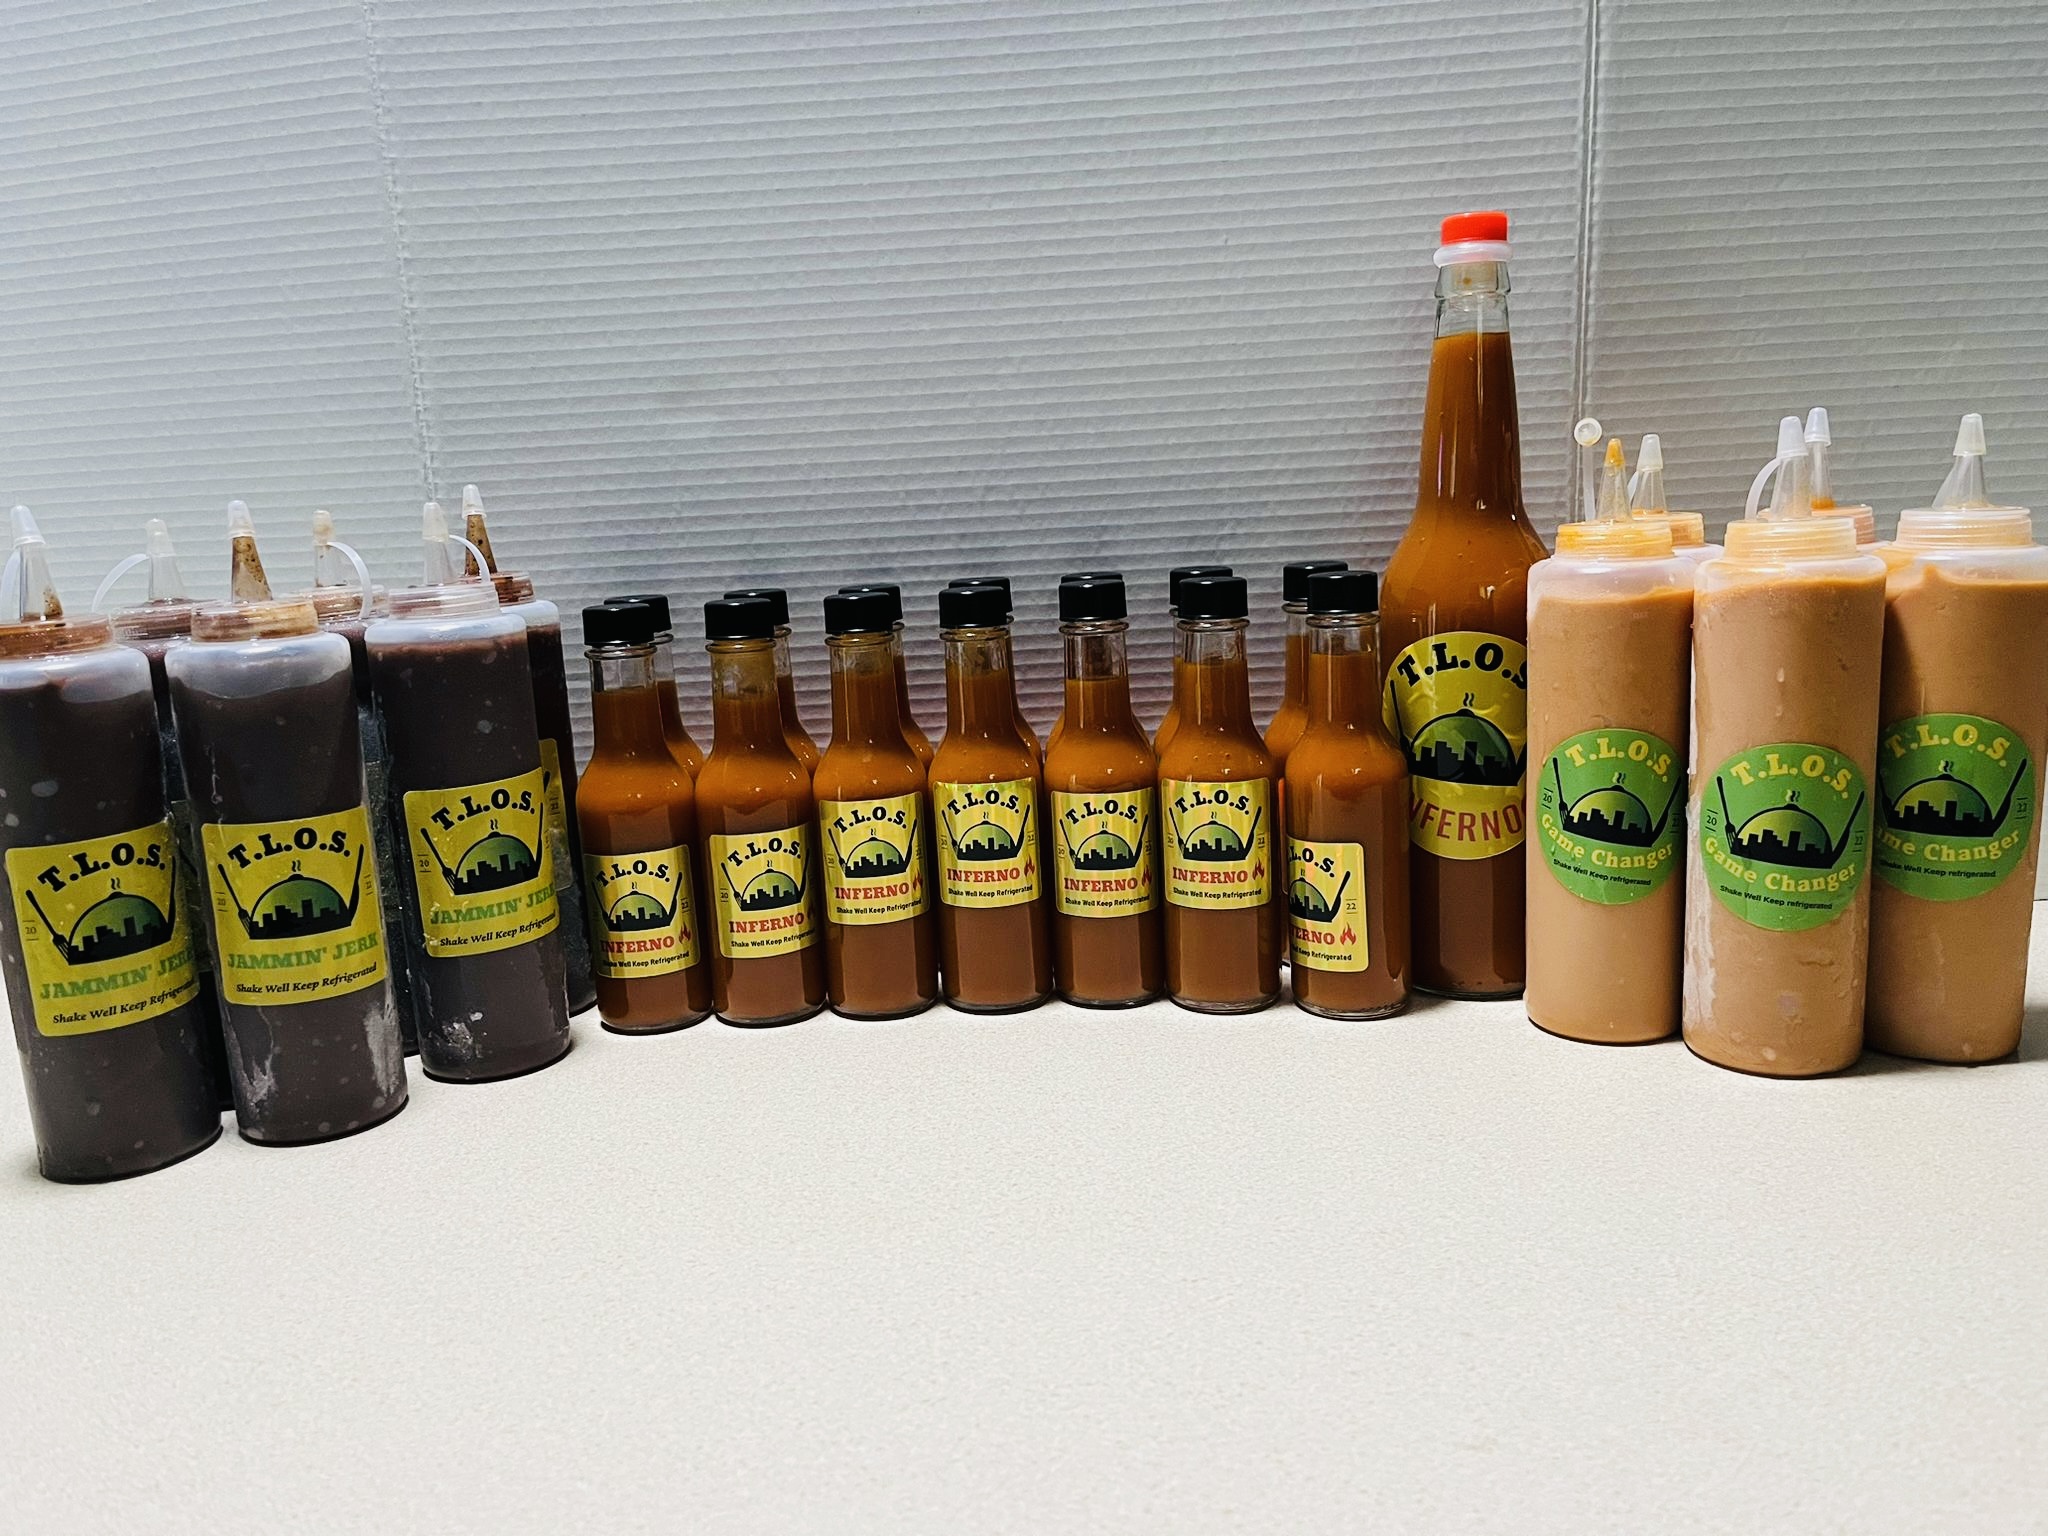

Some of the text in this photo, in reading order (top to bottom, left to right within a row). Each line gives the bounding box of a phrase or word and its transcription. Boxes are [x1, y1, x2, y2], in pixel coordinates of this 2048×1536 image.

[1885, 724, 2010, 768] T.L.O.S.
[1564, 737, 1671, 783] T.L.O.S.
[1730, 753, 1852, 799] T.L.O.S.
[431, 788, 536, 831] T.L.O.S.
[947, 790, 1020, 815] T.L.O.S.
[1065, 799, 1138, 825] T.L.O.S.
[1175, 789, 1249, 815] T.L.O.S.
[833, 806, 907, 833] T.L.O.S.
[1409, 791, 1522, 841] NFERNO
[1706, 816, 1717, 826] 20
[228, 828, 350, 868] T.L.O.S.
[727, 838, 801, 867] T.L.O.S.
[1541, 813, 1673, 870] Game Changer
[1923, 829, 2020, 862] Changer
[37, 842, 166, 892] T.L.O.S.
[419, 859, 430, 868] 20
[596, 860, 670, 887] T.L.O.S.
[947, 868, 1020, 882] INFERNO
[1173, 867, 1248, 884] INFERNO
[1573, 866, 1588, 876] Well
[1589, 871, 1609, 881] Keep
[1705, 837, 1856, 892] Game Changer
[1904, 864, 1922, 873] Well
[1924, 868, 1946, 877] Keep
[1948, 870, 1997, 879] refrigerated
[834, 882, 909, 900] INFERNO
[979, 890, 995, 898] Keep
[996, 884, 1033, 897] Refrigerated
[1064, 877, 1138, 892] INFERNO
[1190, 890, 1203, 898] Well
[1222, 888, 1262, 899] Refrigerated
[1720, 885, 1833, 910] Shake Well Keep refrigerated
[430, 897, 522, 925] JAMMIN'
[729, 912, 805, 933] INFERNO
[227, 932, 378, 969] JAMMIN' JERK
[440, 936, 468, 947] Shake
[470, 933, 493, 944] Well
[496, 929, 517, 940] Keep
[632, 960, 649, 968] Keep
[650, 951, 690, 965] Refrigerated
[1312, 950, 1352, 961] Refrigerated
[40, 964, 152, 999] JAMMIN'
[236, 962, 377, 993] Shake Well Keep Refrigerated
[53, 1013, 87, 1024] Shake
[90, 1007, 117, 1018] Well
[120, 1000, 147, 1016] Keep
